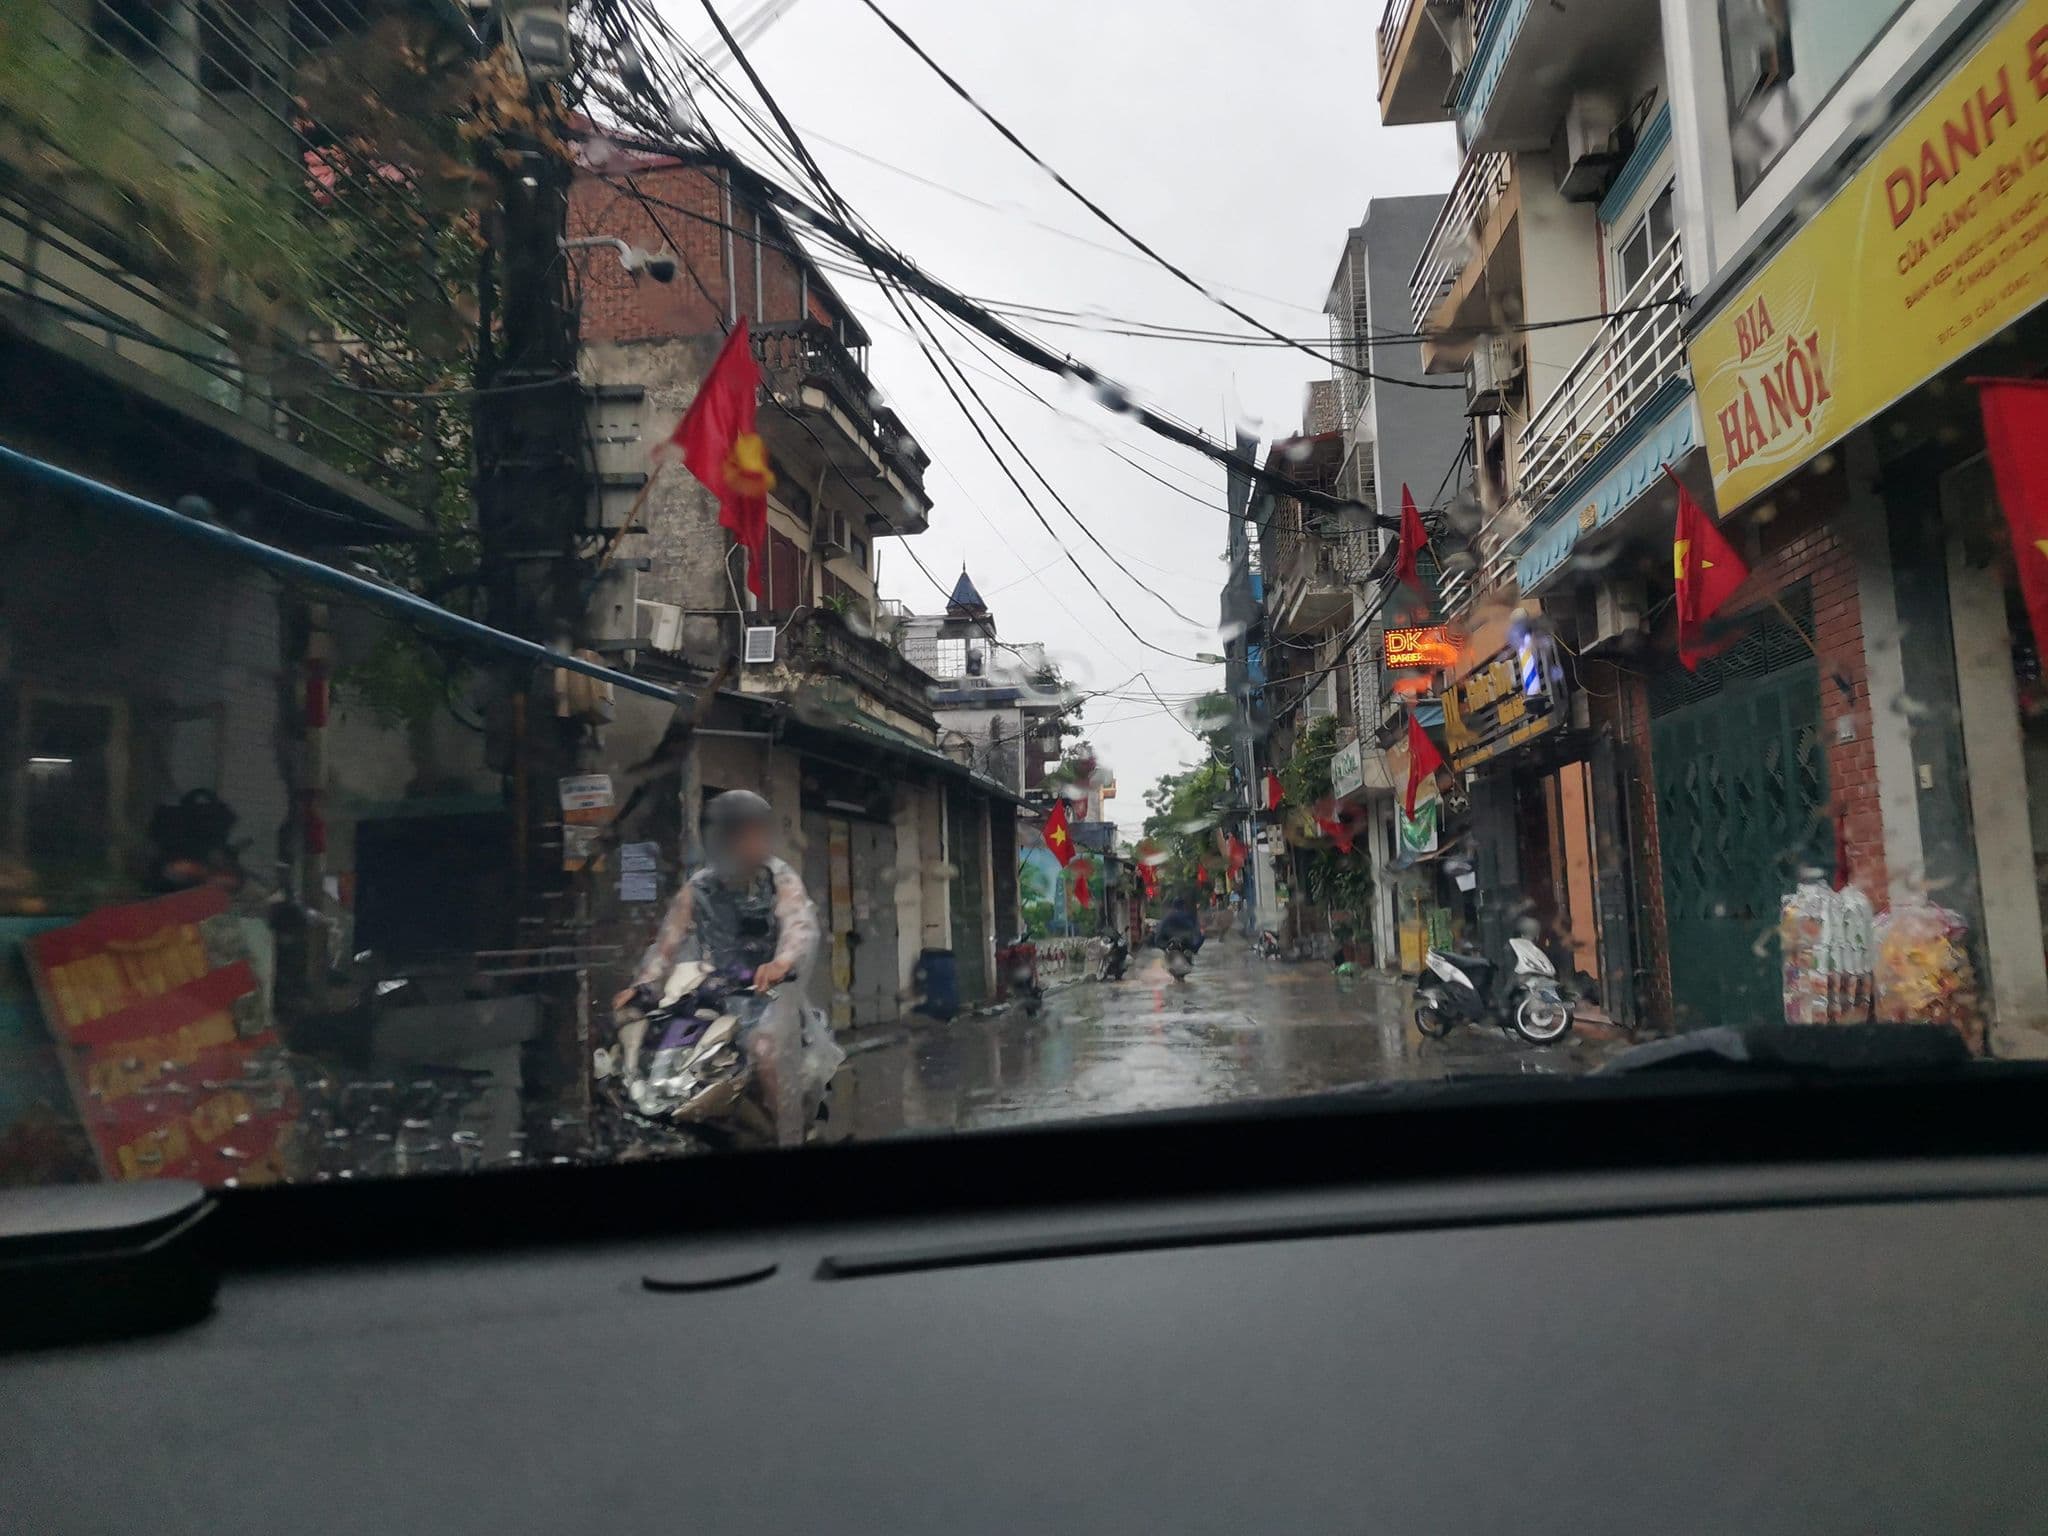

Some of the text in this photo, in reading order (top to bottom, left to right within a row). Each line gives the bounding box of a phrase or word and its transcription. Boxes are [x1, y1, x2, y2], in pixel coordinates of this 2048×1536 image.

[1885, 64, 2016, 231] DANH
[1734, 295, 1775, 363] BIA
[1718, 331, 1831, 473] HÀ NỘI
[1388, 631, 1423, 653] DK
